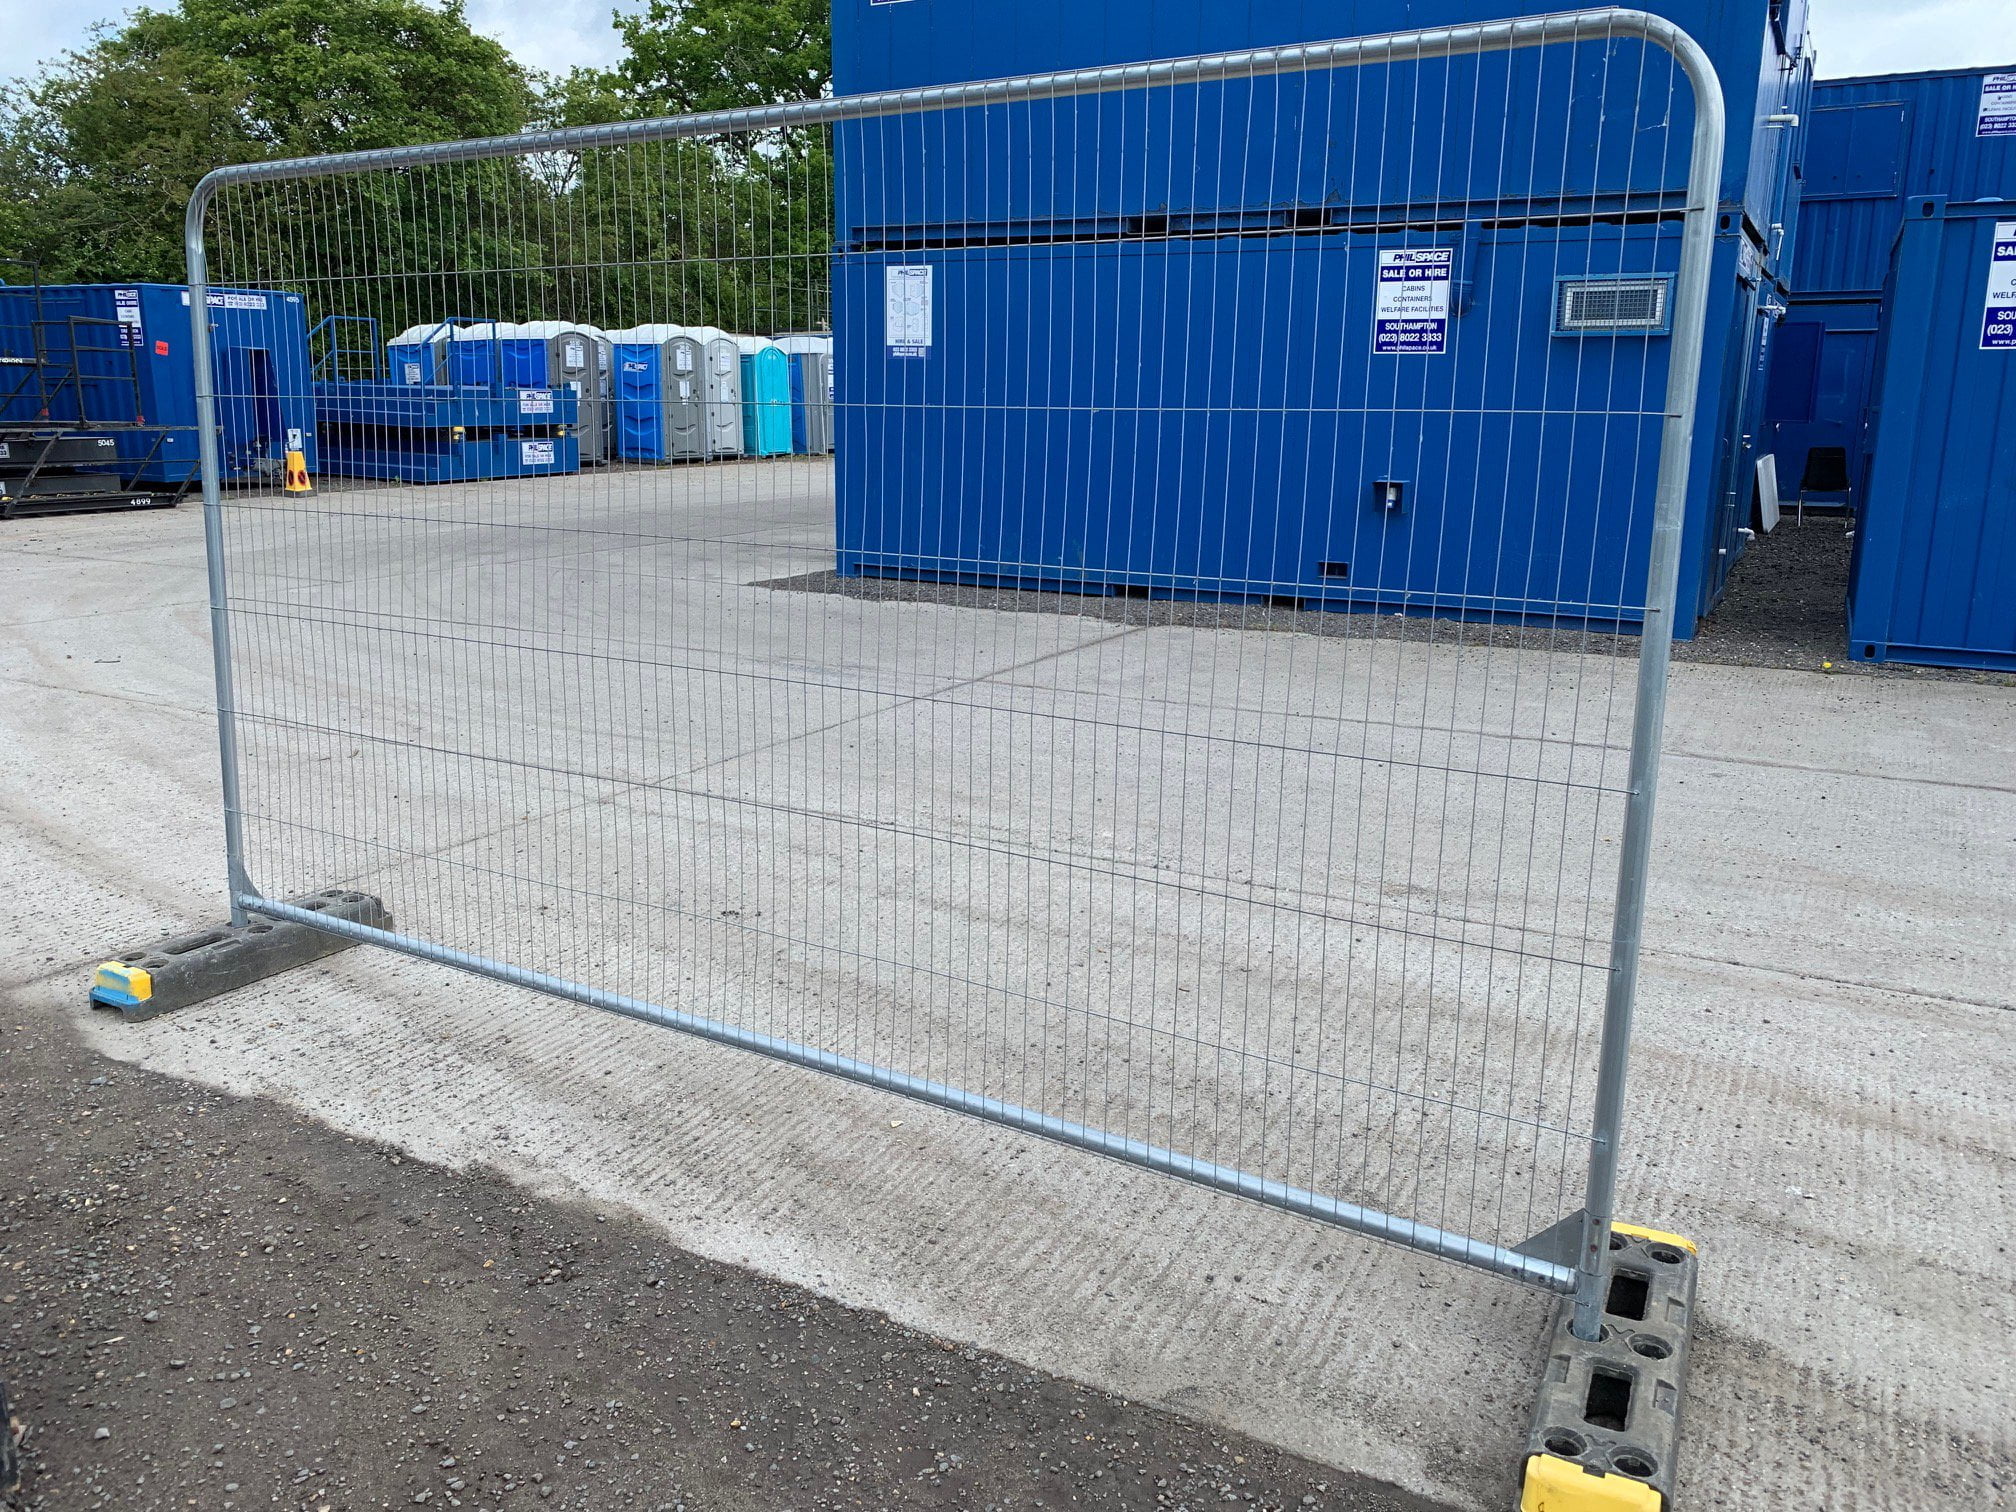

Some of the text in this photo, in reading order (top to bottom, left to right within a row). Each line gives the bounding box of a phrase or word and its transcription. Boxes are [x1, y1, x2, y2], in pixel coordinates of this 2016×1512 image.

[1393, 251, 1449, 262] PHILSPACE
[1382, 269, 1406, 278] SALE
[1408, 268, 1422, 277] OR
[1393, 295, 1432, 303] CONTAINERS
[1385, 322, 1437, 330] SOUTHAMPTON
[1987, 324, 2013, 337] (023)
[1379, 333, 1442, 343] (023) 8022 3333
